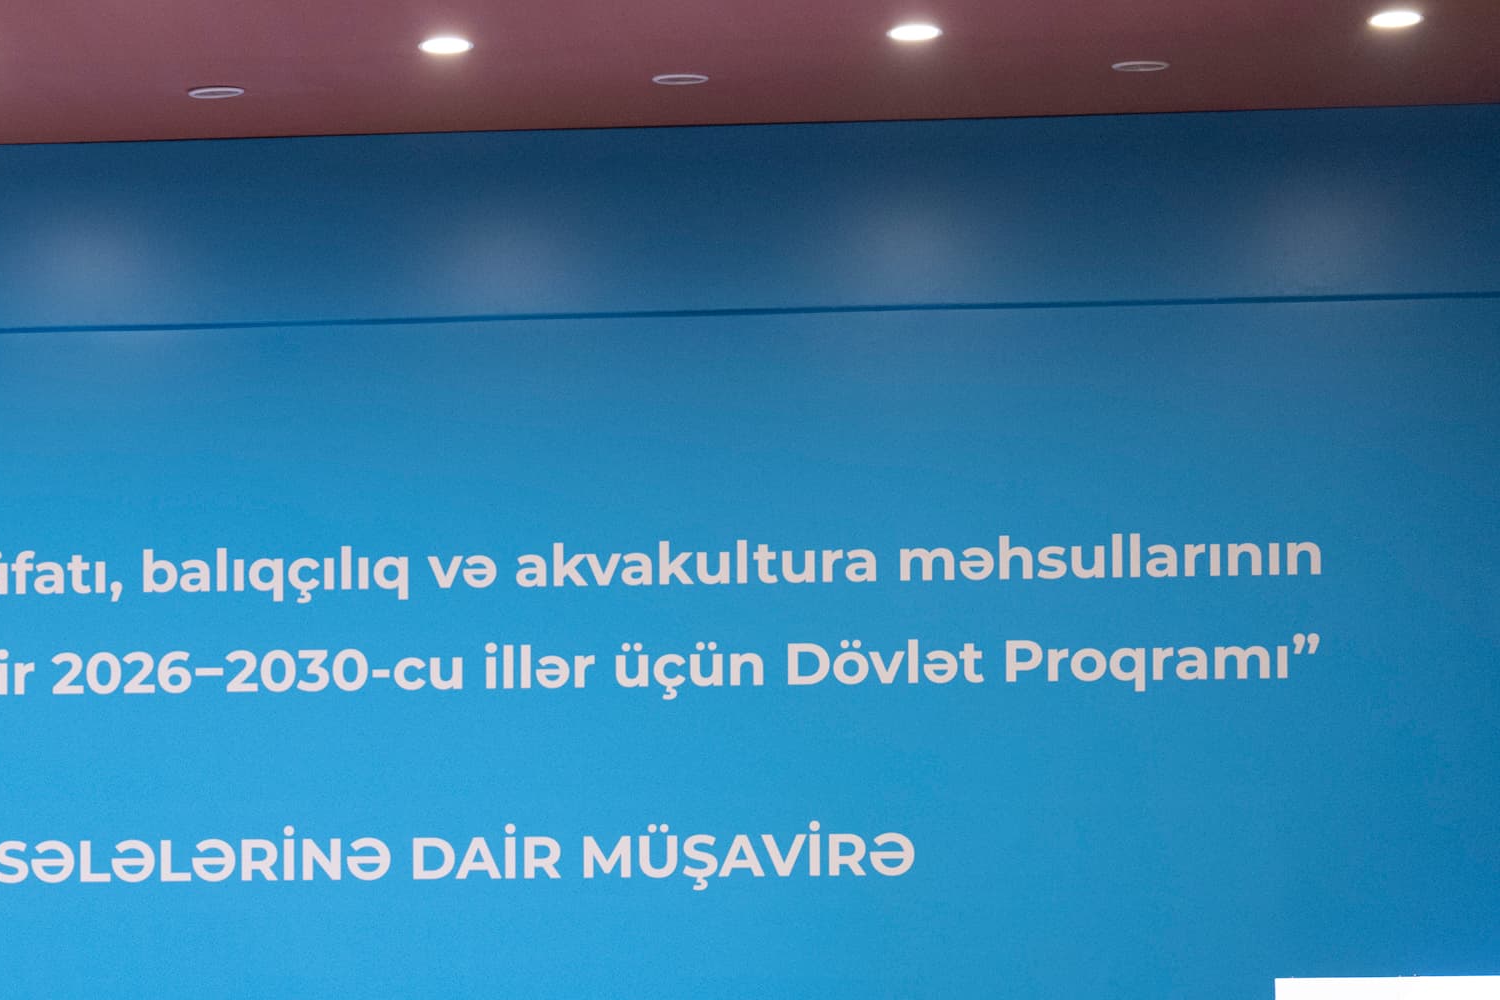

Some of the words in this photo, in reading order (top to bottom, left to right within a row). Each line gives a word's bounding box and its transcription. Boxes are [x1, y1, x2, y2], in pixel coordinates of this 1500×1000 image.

[142, 545, 409, 604] balıqçılıq
[427, 555, 497, 589] və
[515, 539, 877, 588] akvakultura
[899, 533, 1321, 581] məhsullarının
[484, 642, 596, 689] illər
[615, 641, 764, 701] üçün
[787, 639, 984, 686] Dövlət
[1005, 633, 1320, 692] Proqramı”
[412, 823, 561, 880] DAİR
[583, 820, 915, 891] MÜŞAVİRƏ
